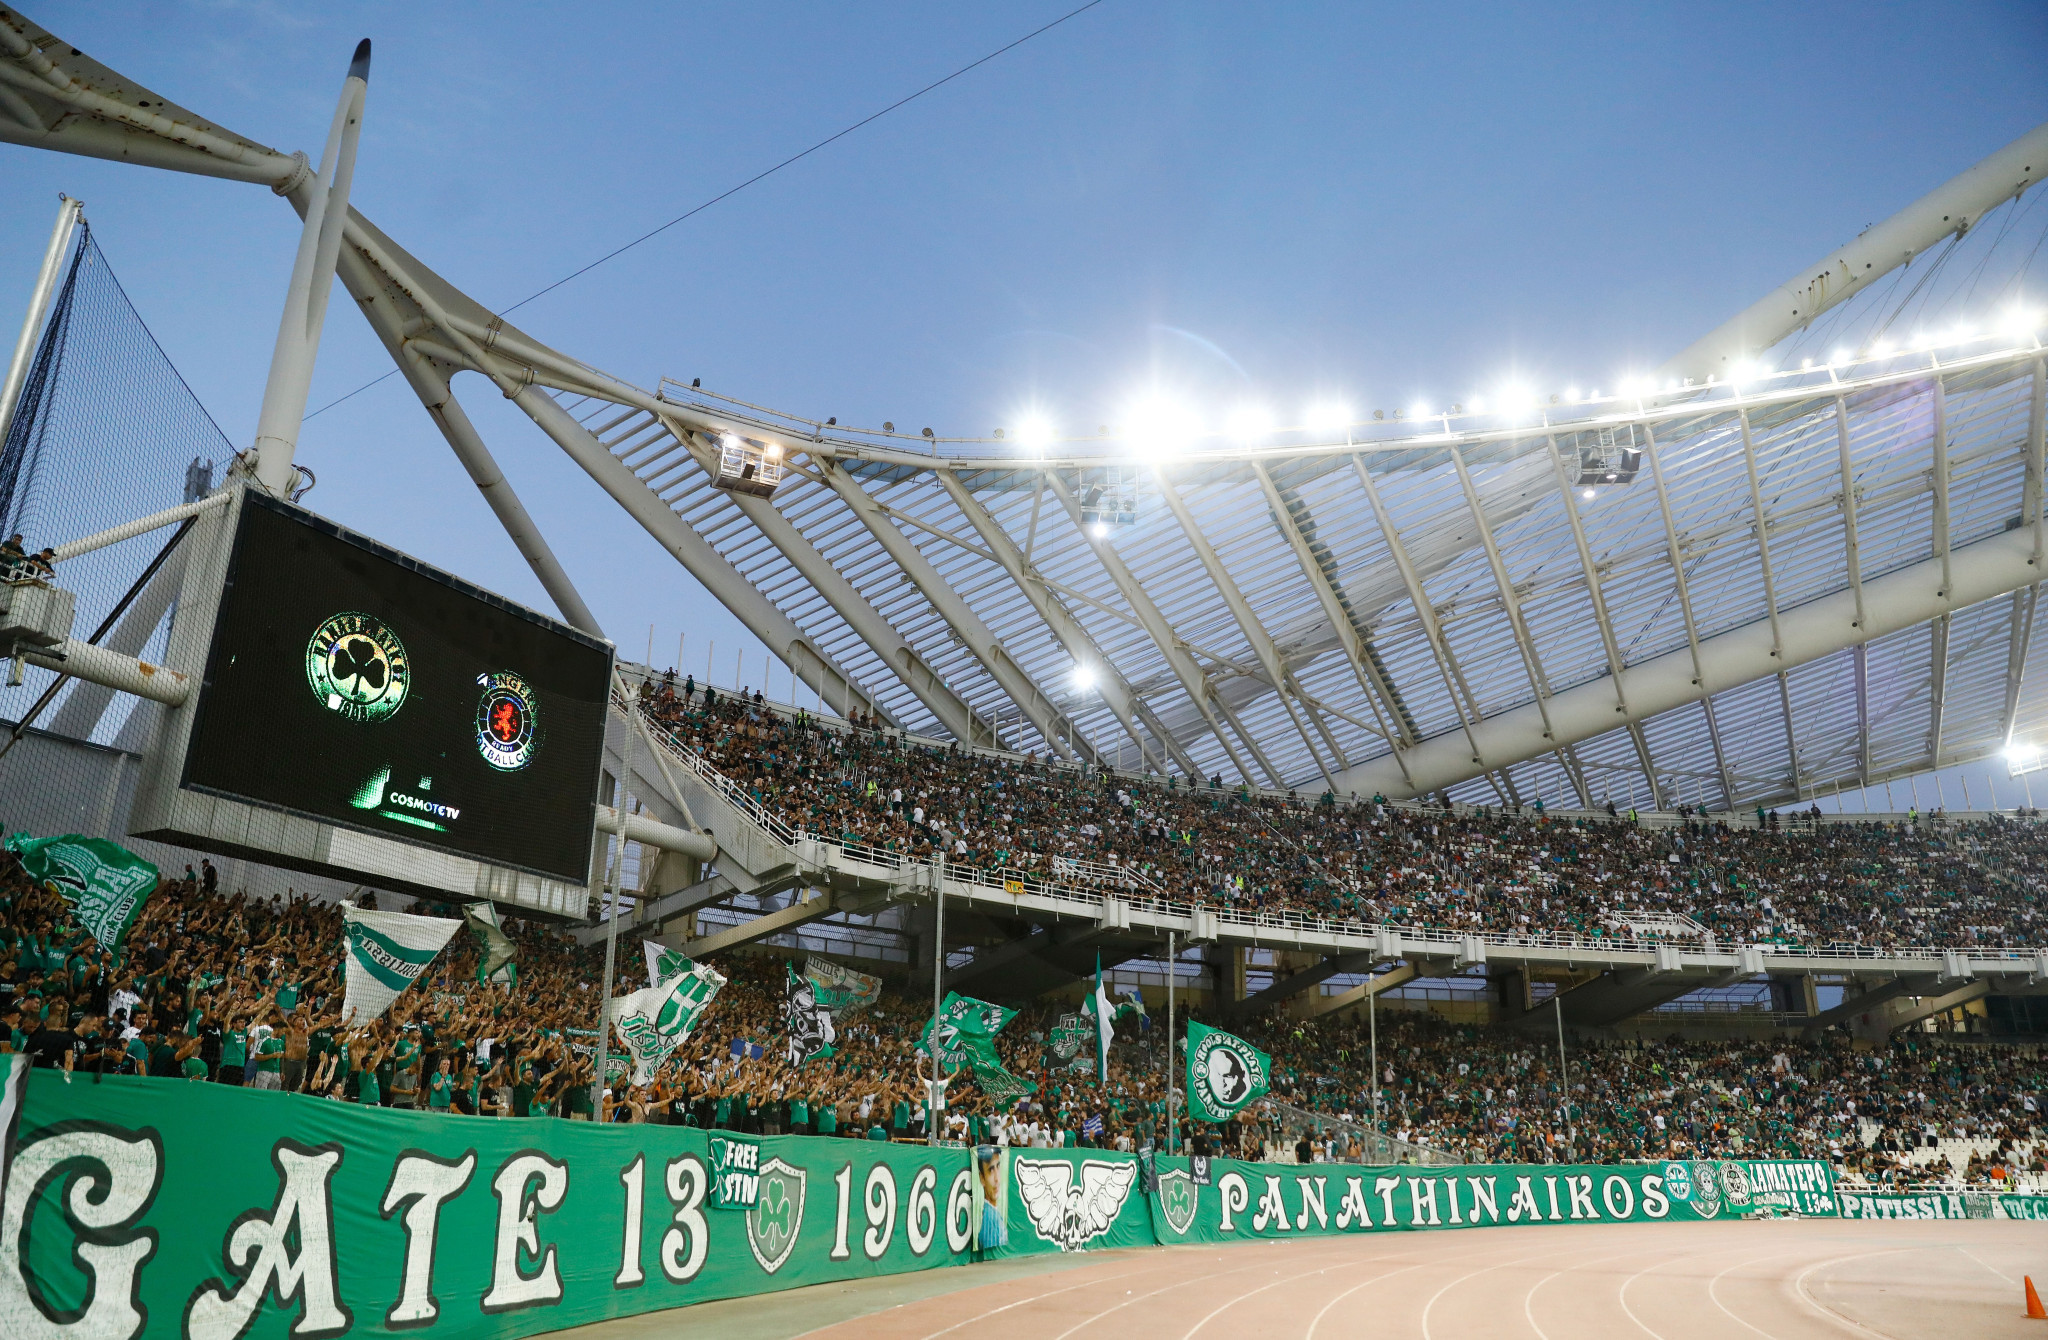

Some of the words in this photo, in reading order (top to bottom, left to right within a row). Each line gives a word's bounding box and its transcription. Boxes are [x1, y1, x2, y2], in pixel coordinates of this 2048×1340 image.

[103, 929, 115, 945] FAN
[113, 897, 136, 922] CLUB
[1196, 1034, 1223, 1061] HOOLS
[1223, 1036, 1240, 1048] AT
[1238, 1044, 1261, 1075] PLAY
[726, 1140, 759, 1171] FREE
[1217, 1171, 1670, 1232] PANATHINAIKOS
[1840, 1194, 1967, 1219] PATISSIA
[0, 1119, 569, 1340] GATE
[613, 1151, 710, 1290] 13
[829, 1160, 973, 1262] 1966
